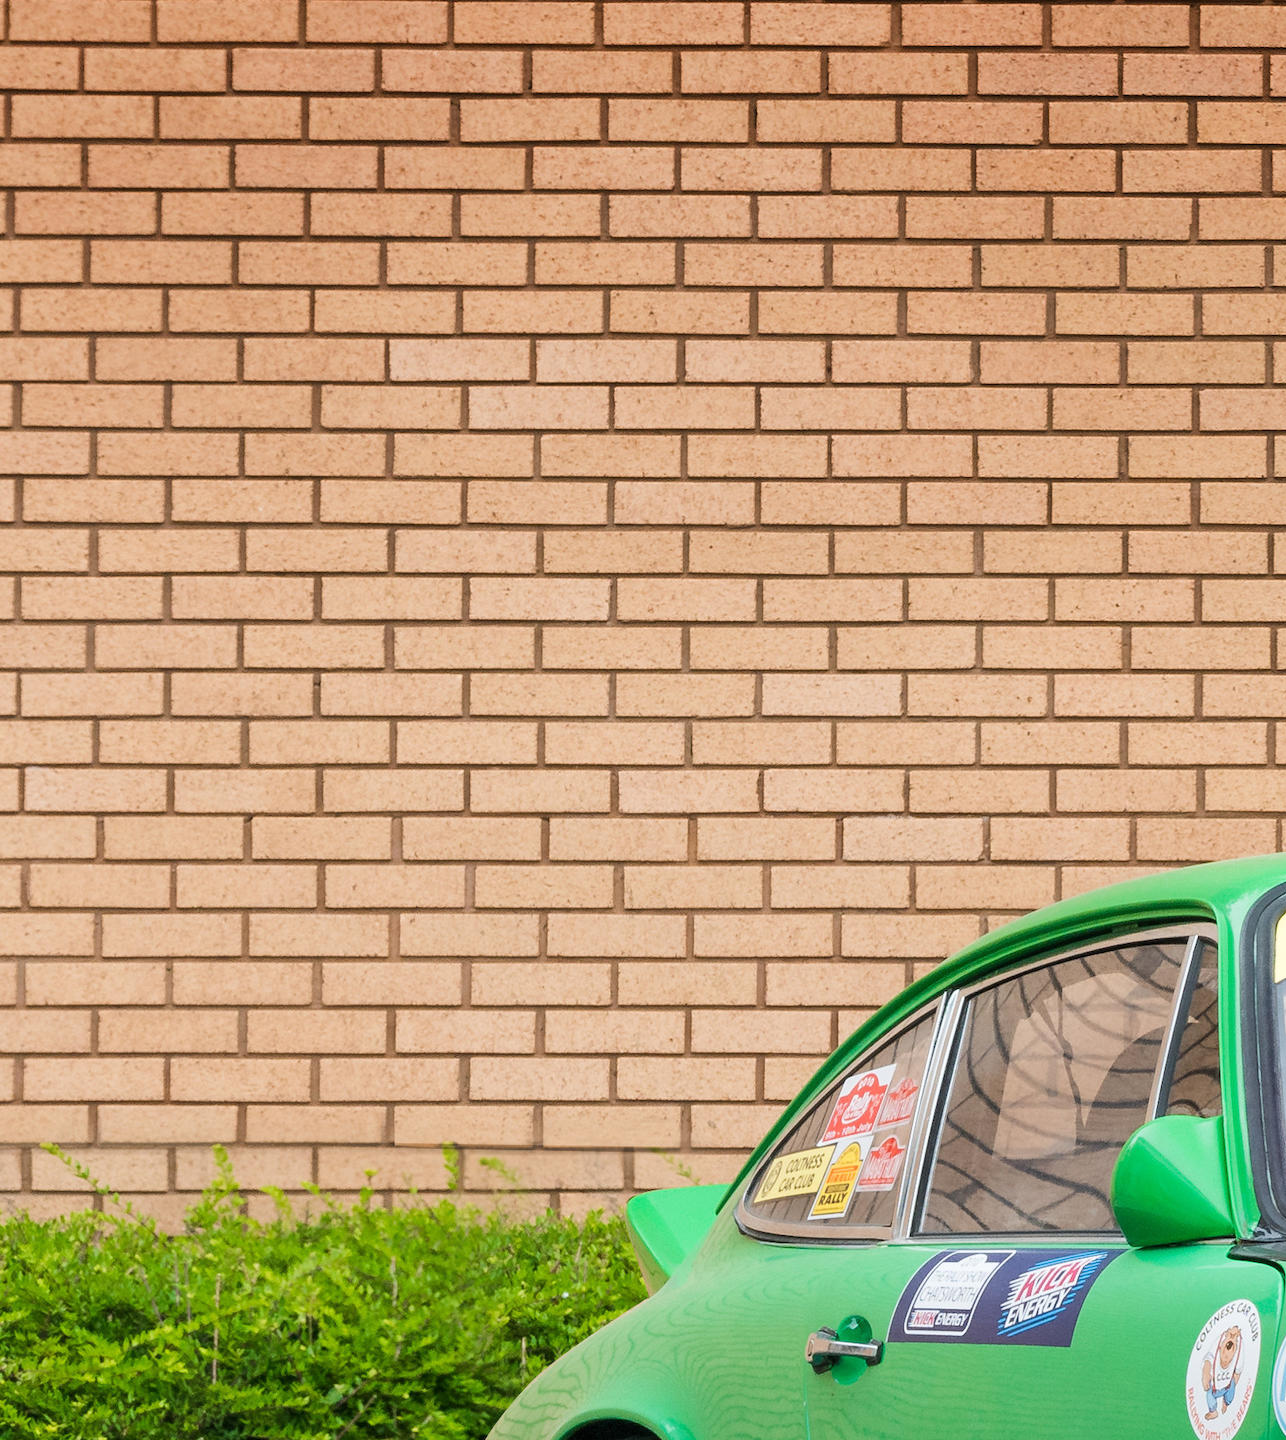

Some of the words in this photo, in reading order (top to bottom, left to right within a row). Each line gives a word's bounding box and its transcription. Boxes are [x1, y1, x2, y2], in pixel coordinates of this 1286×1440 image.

[785, 1153, 825, 1174] COLTNESS
[778, 1176, 795, 1193] CAR
[793, 1173, 815, 1190] CLUB
[818, 1191, 848, 1206] RALLY
[1014, 1259, 1084, 1303] KICK
[1004, 1288, 1073, 1328] ENERGY
[935, 1313, 970, 1327] ENERGY
[1195, 1303, 1236, 1351] COLTNESS
[1236, 1302, 1251, 1316] CAR
[1248, 1313, 1260, 1342] CLUB
[1216, 1371, 1231, 1382] CCC
[1187, 1386, 1206, 1436] RALLYING
